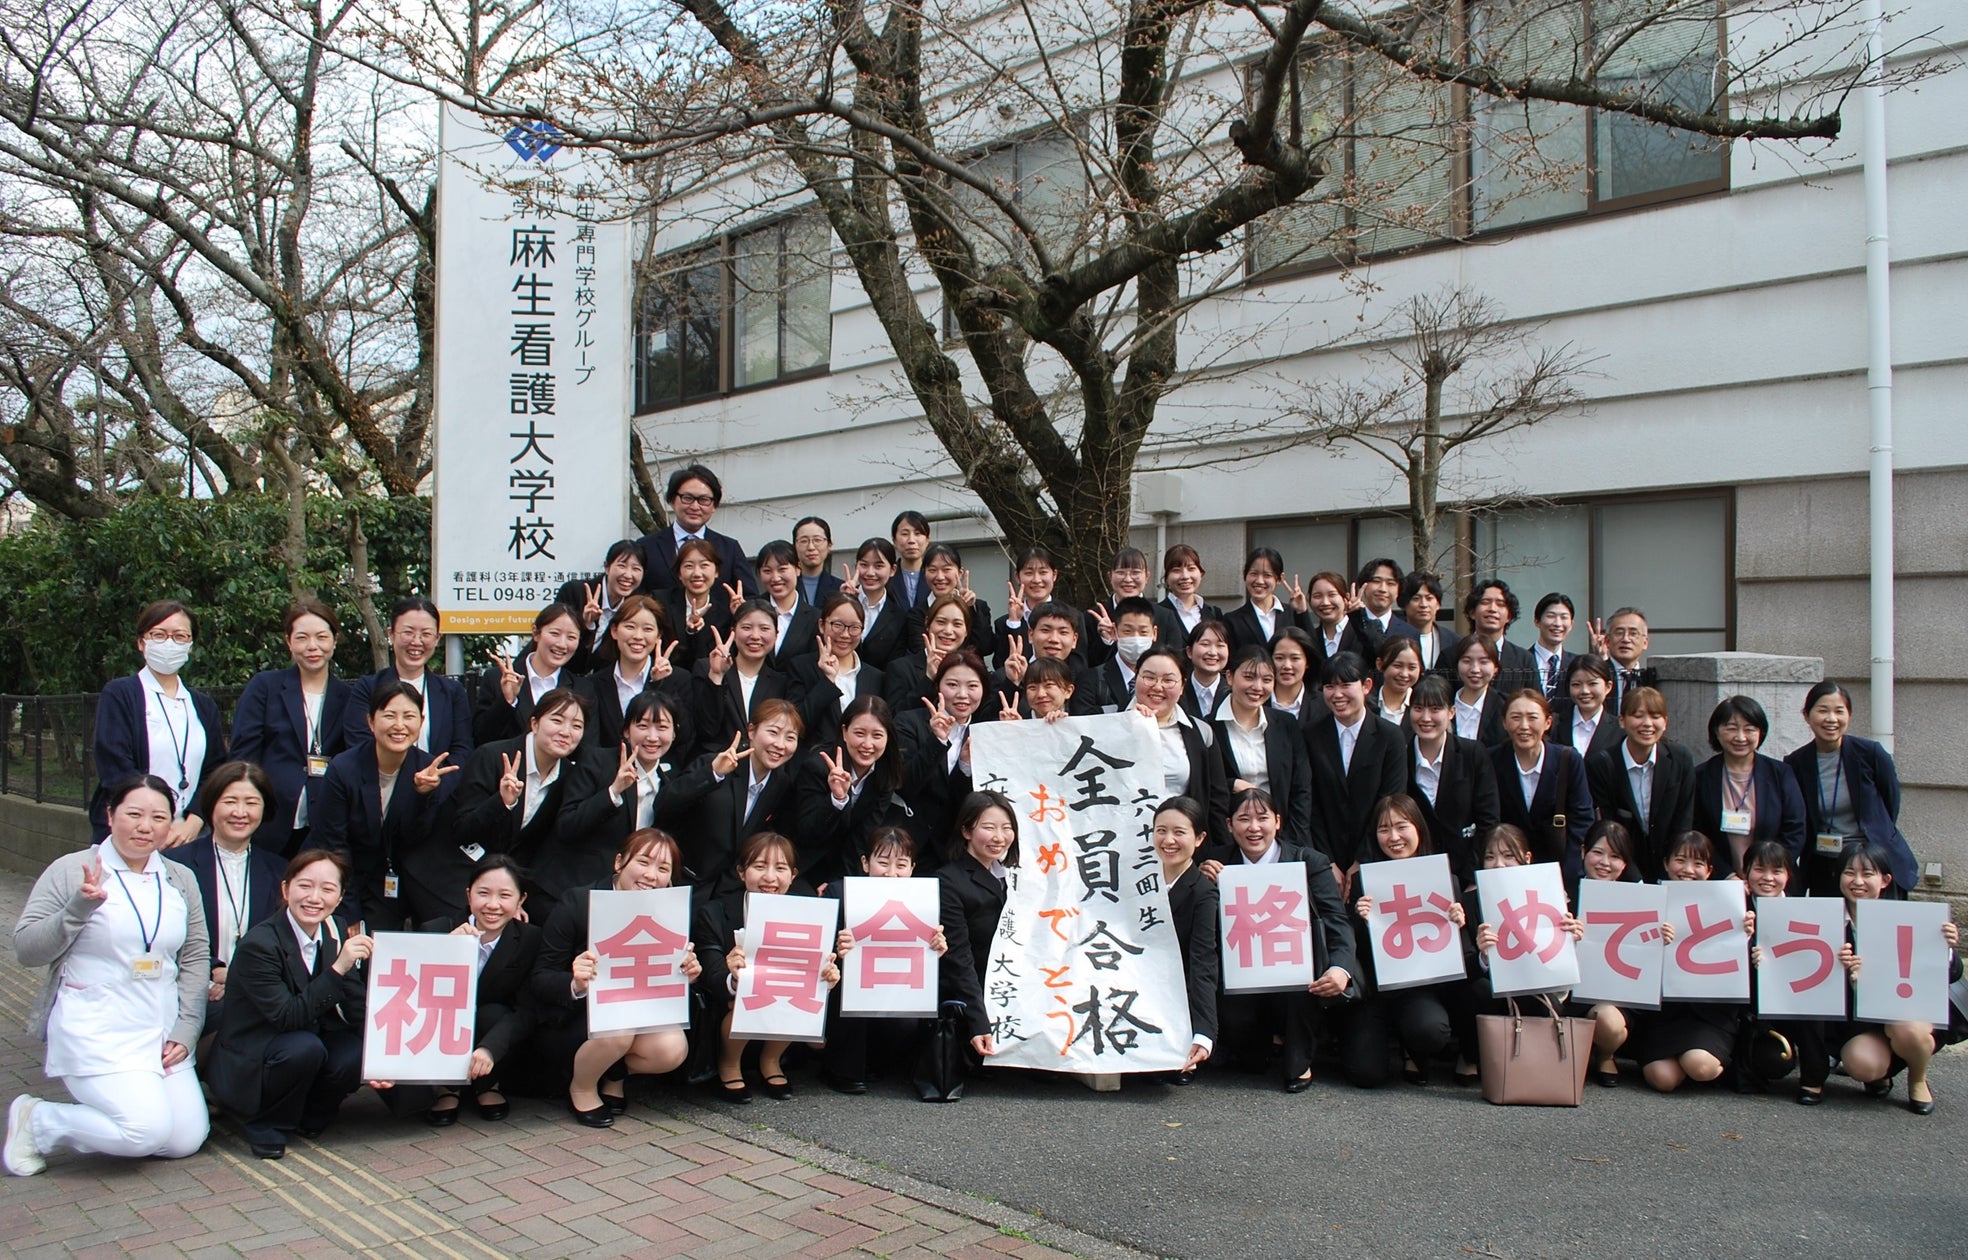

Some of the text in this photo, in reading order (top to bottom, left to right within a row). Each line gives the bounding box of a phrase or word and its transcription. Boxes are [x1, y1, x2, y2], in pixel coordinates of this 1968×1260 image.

[508, 225, 556, 560] 麻生看護大学校
[449, 616, 481, 625] Design
[453, 588, 489, 601] TEL
[373, 958, 472, 1055] 祝
[594, 915, 687, 1004] 全
[742, 921, 824, 1014] 員
[851, 899, 937, 989] 合
[1225, 884, 1308, 968] 格
[1379, 884, 1452, 960] お
[1495, 889, 1567, 964] め
[1586, 910, 1660, 980] で
[1675, 903, 1740, 975] と
[1771, 920, 1834, 993] う
[1029, 784, 1080, 1056] おめでとう
[1058, 735, 1162, 1056] 全員合格
